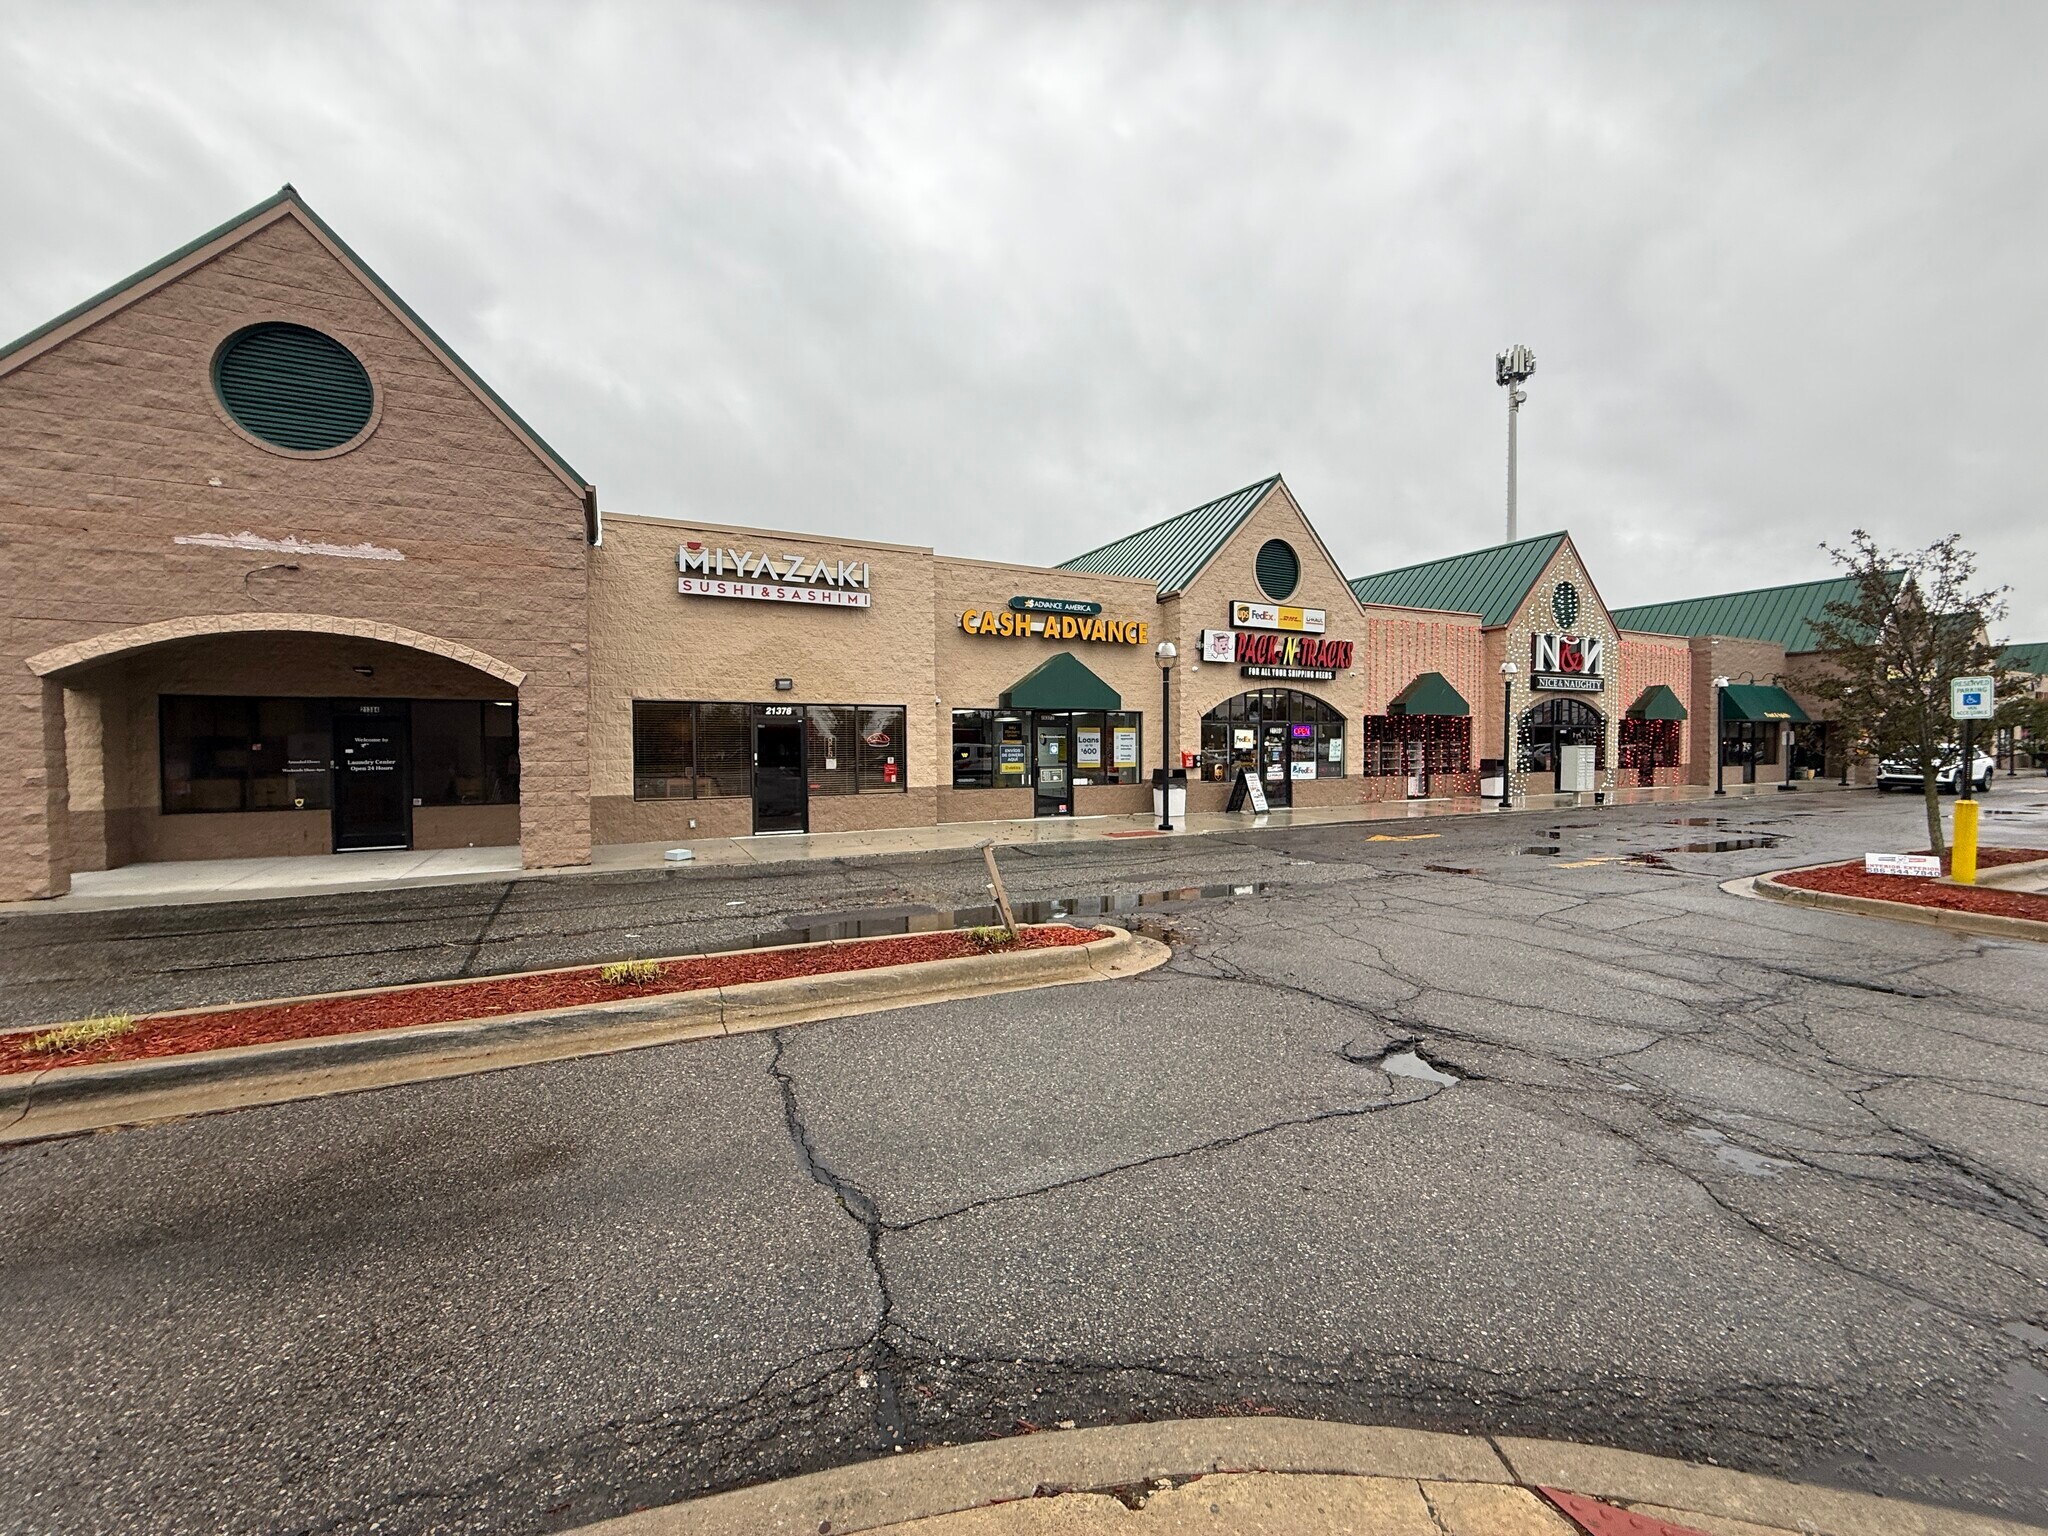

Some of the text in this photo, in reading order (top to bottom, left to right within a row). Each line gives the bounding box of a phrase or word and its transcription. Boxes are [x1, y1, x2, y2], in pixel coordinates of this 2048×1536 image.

[679, 545, 869, 588] MIYAZAKI
[683, 580, 868, 605] SUSHI&SASHIMI
[1035, 601, 1091, 612] ADVANCE AMERICA
[1251, 609, 1274, 621] FedEx
[963, 610, 1148, 645] CASH ADVANCE
[1248, 667, 1333, 679] FOR ALL YOUR SHIPPING NEEDS
[766, 707, 792, 715] 21378
[1236, 735, 1251, 743] FedEx
